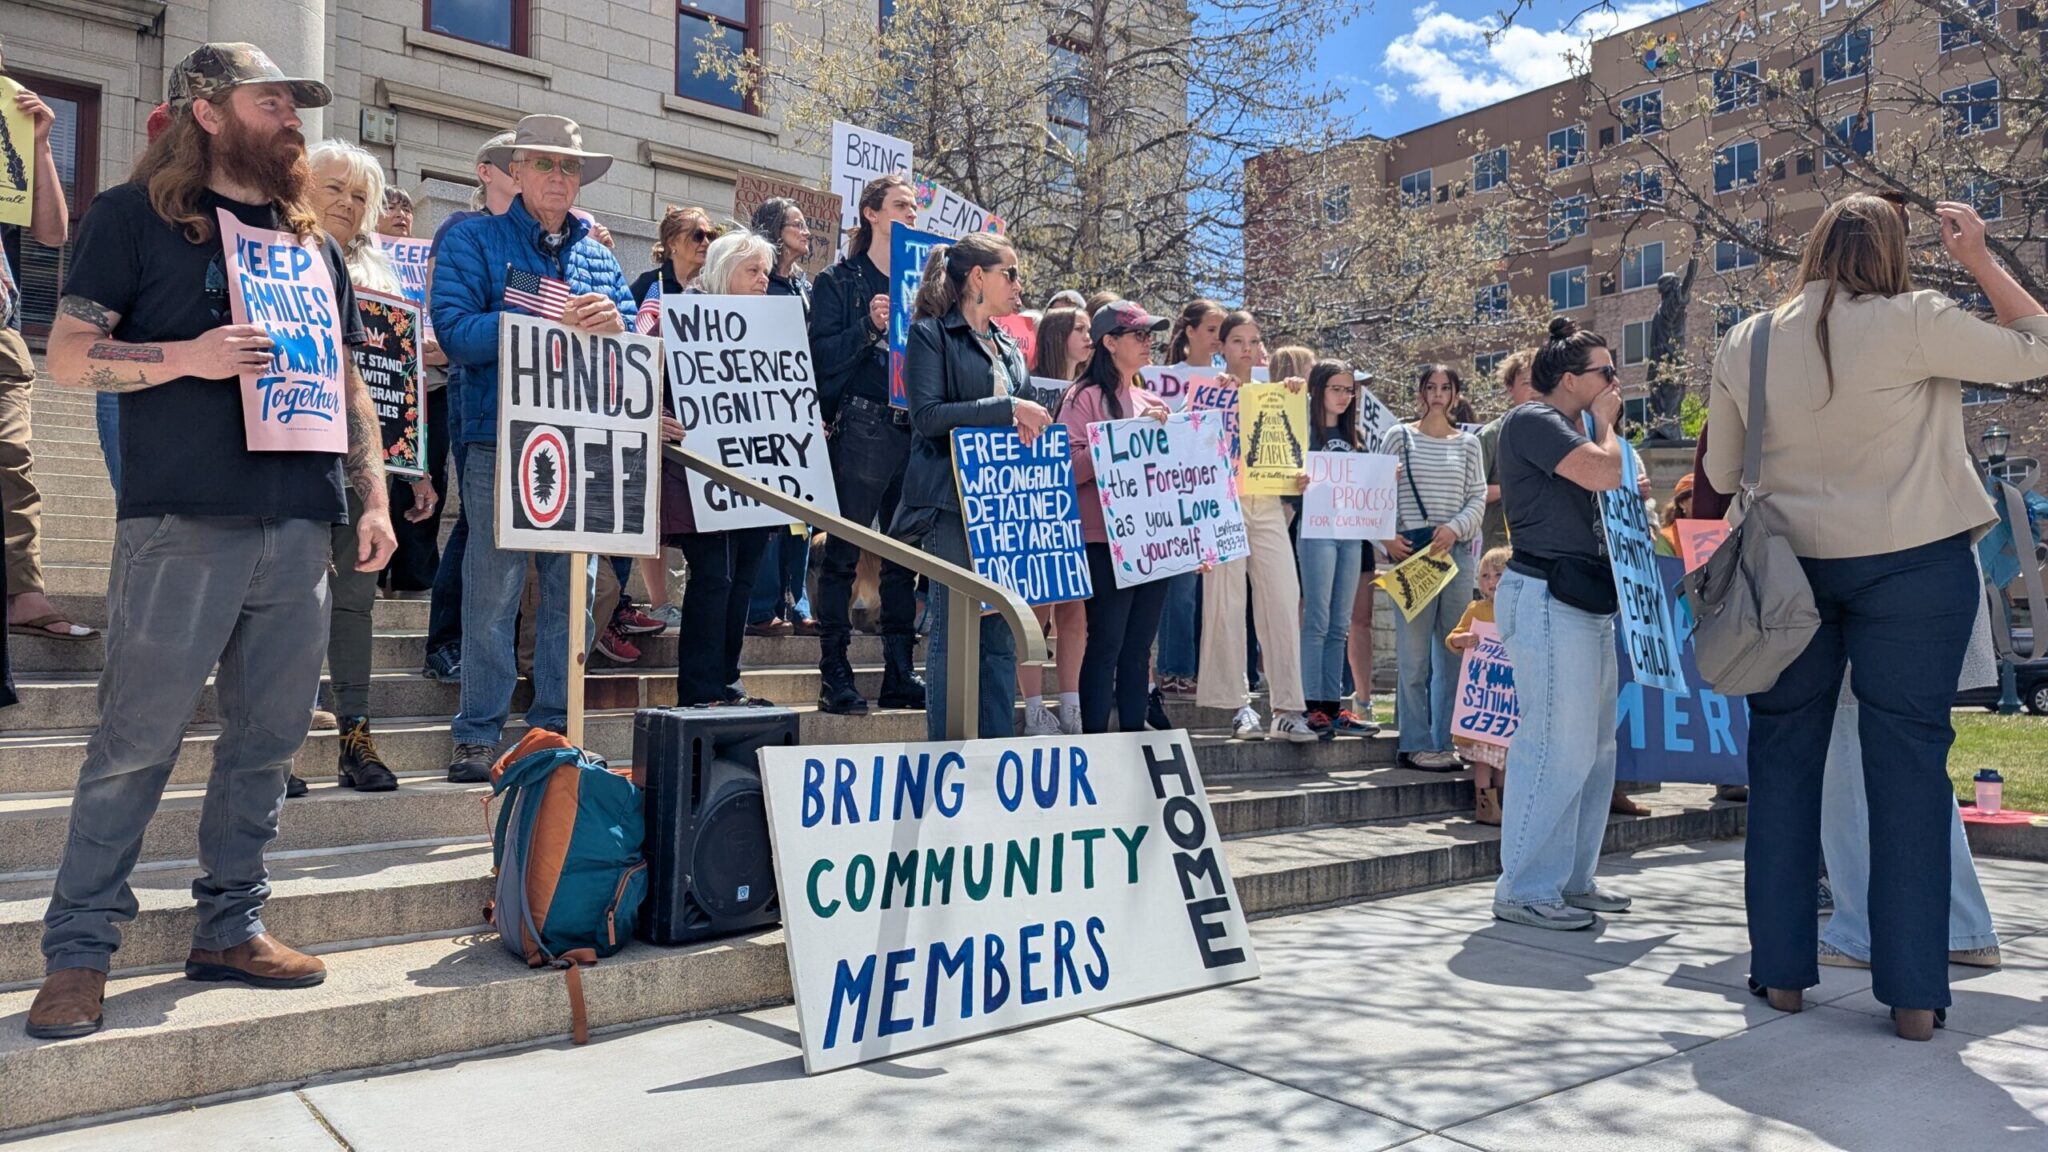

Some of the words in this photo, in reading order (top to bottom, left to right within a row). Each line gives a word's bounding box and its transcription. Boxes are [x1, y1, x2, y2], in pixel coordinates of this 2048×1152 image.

[846, 133, 908, 176] BRING
[741, 176, 769, 193] END
[940, 195, 982, 234] END
[236, 233, 313, 282] KEEP
[239, 272, 333, 329] FAMILIES
[667, 304, 747, 343] WHO
[362, 368, 391, 386] WITH
[368, 354, 403, 373] STAND
[511, 324, 654, 420] HANDS
[673, 349, 809, 386] DESERVES
[256, 376, 340, 424] Together
[367, 386, 406, 405] IGRANT
[374, 403, 399, 419] ILIES
[679, 387, 819, 431] DIGNITY?
[1193, 385, 1239, 409] KEEP
[1363, 394, 1380, 429] BE
[717, 433, 814, 469] EVERY
[958, 432, 1021, 465] FREE
[1032, 430, 1067, 459] THE
[1106, 422, 1170, 464] Love
[518, 424, 642, 534] OFF
[960, 459, 1072, 495] WRONGFULLY
[1108, 468, 1138, 499] the
[1144, 462, 1218, 498] Foreigner
[1312, 455, 1357, 485] DUE
[964, 489, 1072, 524] DETAINED
[1115, 514, 1136, 538] as
[1145, 510, 1173, 537] you
[1178, 498, 1220, 526] Love
[1332, 486, 1395, 512] PROCESS
[968, 522, 1026, 554] THEY
[1310, 514, 1330, 527] FOR
[1137, 526, 1205, 576] yourself.
[974, 549, 1093, 601] FORGOTTEN
[1623, 576, 1664, 634] EVERY
[1631, 630, 1676, 678] CHILD.
[1463, 684, 1520, 718] AMILIES
[801, 751, 966, 829] BRING
[997, 746, 1097, 813] OUR
[806, 825, 1149, 918] COMMUNITY
[1141, 743, 1247, 969] HOME
[822, 916, 1110, 1050] MEMBERS
